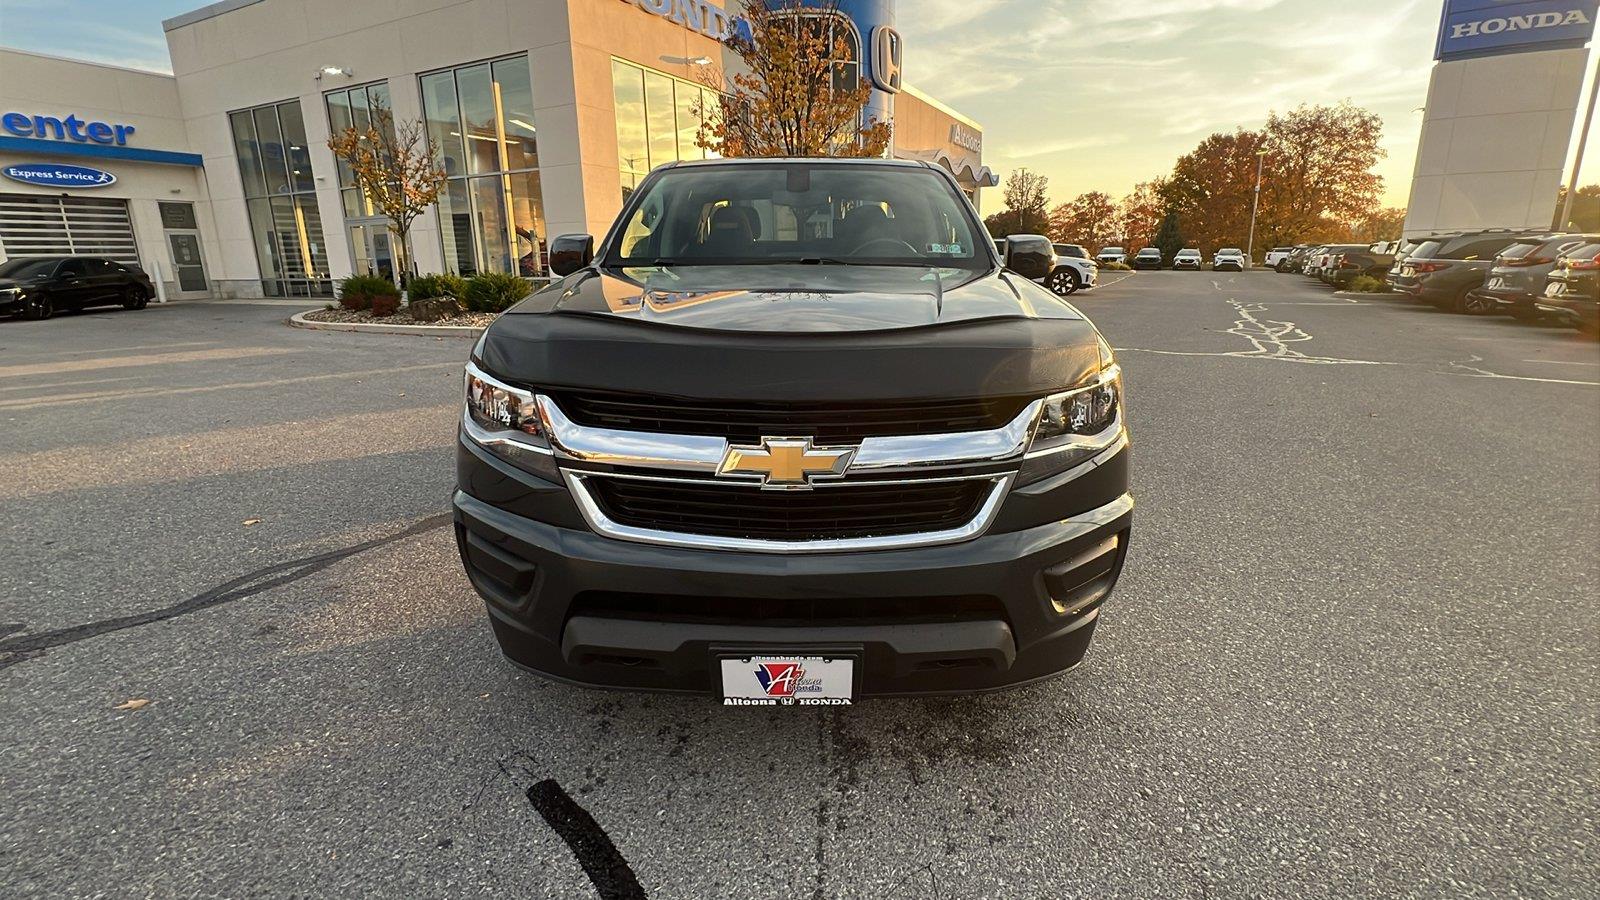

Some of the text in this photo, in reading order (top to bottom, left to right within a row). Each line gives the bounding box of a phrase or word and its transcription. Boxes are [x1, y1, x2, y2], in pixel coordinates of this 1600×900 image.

[1450, 9, 1590, 39] HONDA
[1, 112, 135, 145] enter
[9, 168, 95, 181] Express Service
[723, 698, 853, 706] Altoona HONDA
